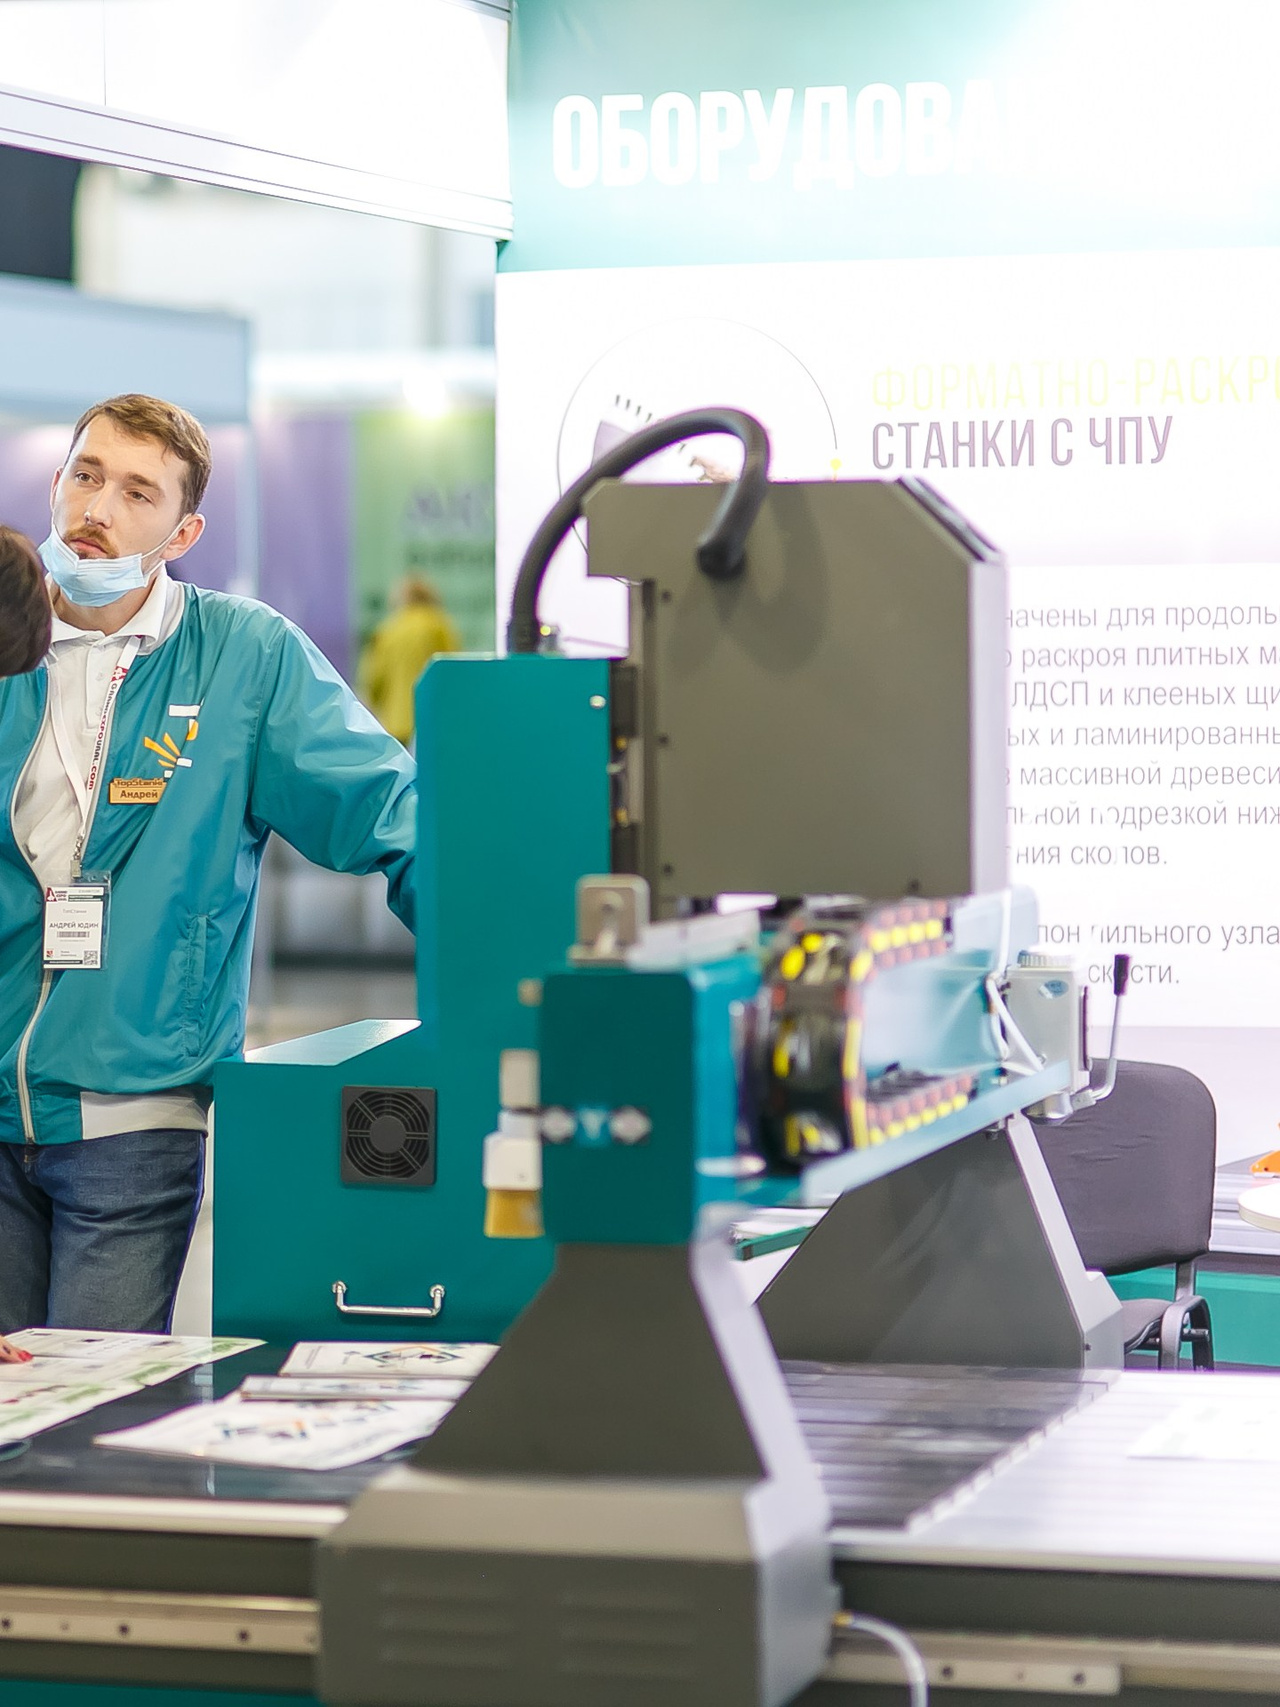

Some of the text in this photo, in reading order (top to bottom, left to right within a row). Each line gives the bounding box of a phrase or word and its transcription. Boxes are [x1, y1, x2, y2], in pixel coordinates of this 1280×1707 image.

[551, 78, 1032, 191] ОБОРУДОВА
[872, 415, 1174, 470] СТАНКИ С ЧПУ
[1106, 607, 1155, 631] для
[1022, 647, 1126, 674] раскроя
[1136, 646, 1250, 666] плитных
[1012, 680, 1089, 712] ЛДСП
[1099, 687, 1114, 706] и
[1124, 686, 1236, 706] клееных
[1050, 727, 1064, 746] и
[1020, 759, 1161, 786] массивной
[1170, 765, 1280, 792] древеси
[120, 789, 158, 799] Андрей
[1005, 845, 1061, 865] ния
[49, 921, 76, 929] АНДРЕЙ
[1221, 924, 1280, 952] узла
[1087, 964, 1180, 984] сксти.
